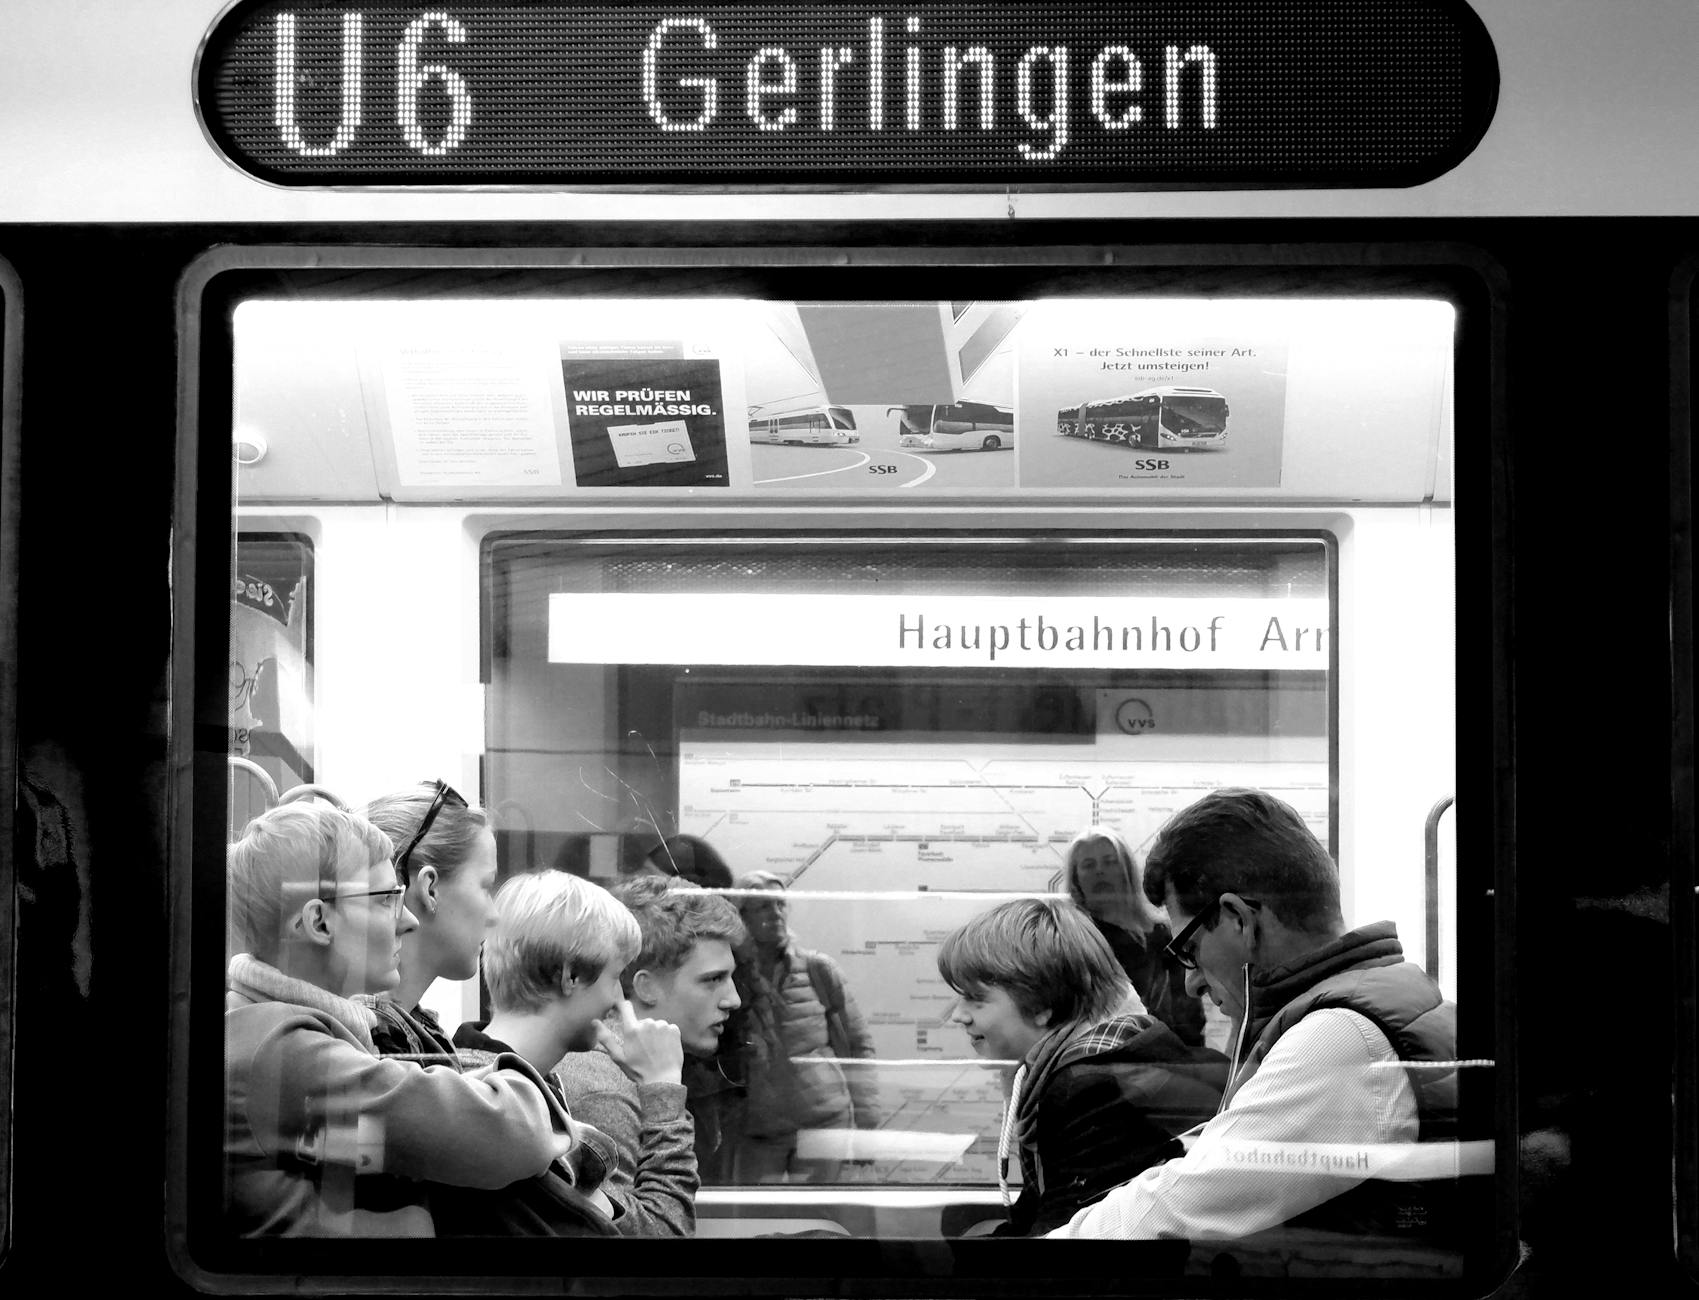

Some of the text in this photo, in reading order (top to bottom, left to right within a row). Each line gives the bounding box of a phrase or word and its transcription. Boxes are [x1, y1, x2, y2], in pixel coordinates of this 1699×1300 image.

[274, 11, 1221, 162] U6 Gerlingen
[1053, 348, 1069, 357] X1
[1089, 348, 1111, 357] der
[1116, 348, 1182, 357] Schnellste
[1187, 348, 1226, 357] seiner
[1231, 348, 1257, 357] Art.
[1101, 361, 1209, 373] Jetzt umsteigen!
[573, 387, 691, 402] WIR PRÜFEN
[575, 402, 717, 416] REGELMÄSSIG.
[868, 465, 898, 475] SSB
[1135, 459, 1170, 471] SSB
[899, 614, 1224, 661] Hauptbahnhof
[698, 710, 880, 728] Stadtbahn-Liniennetz
